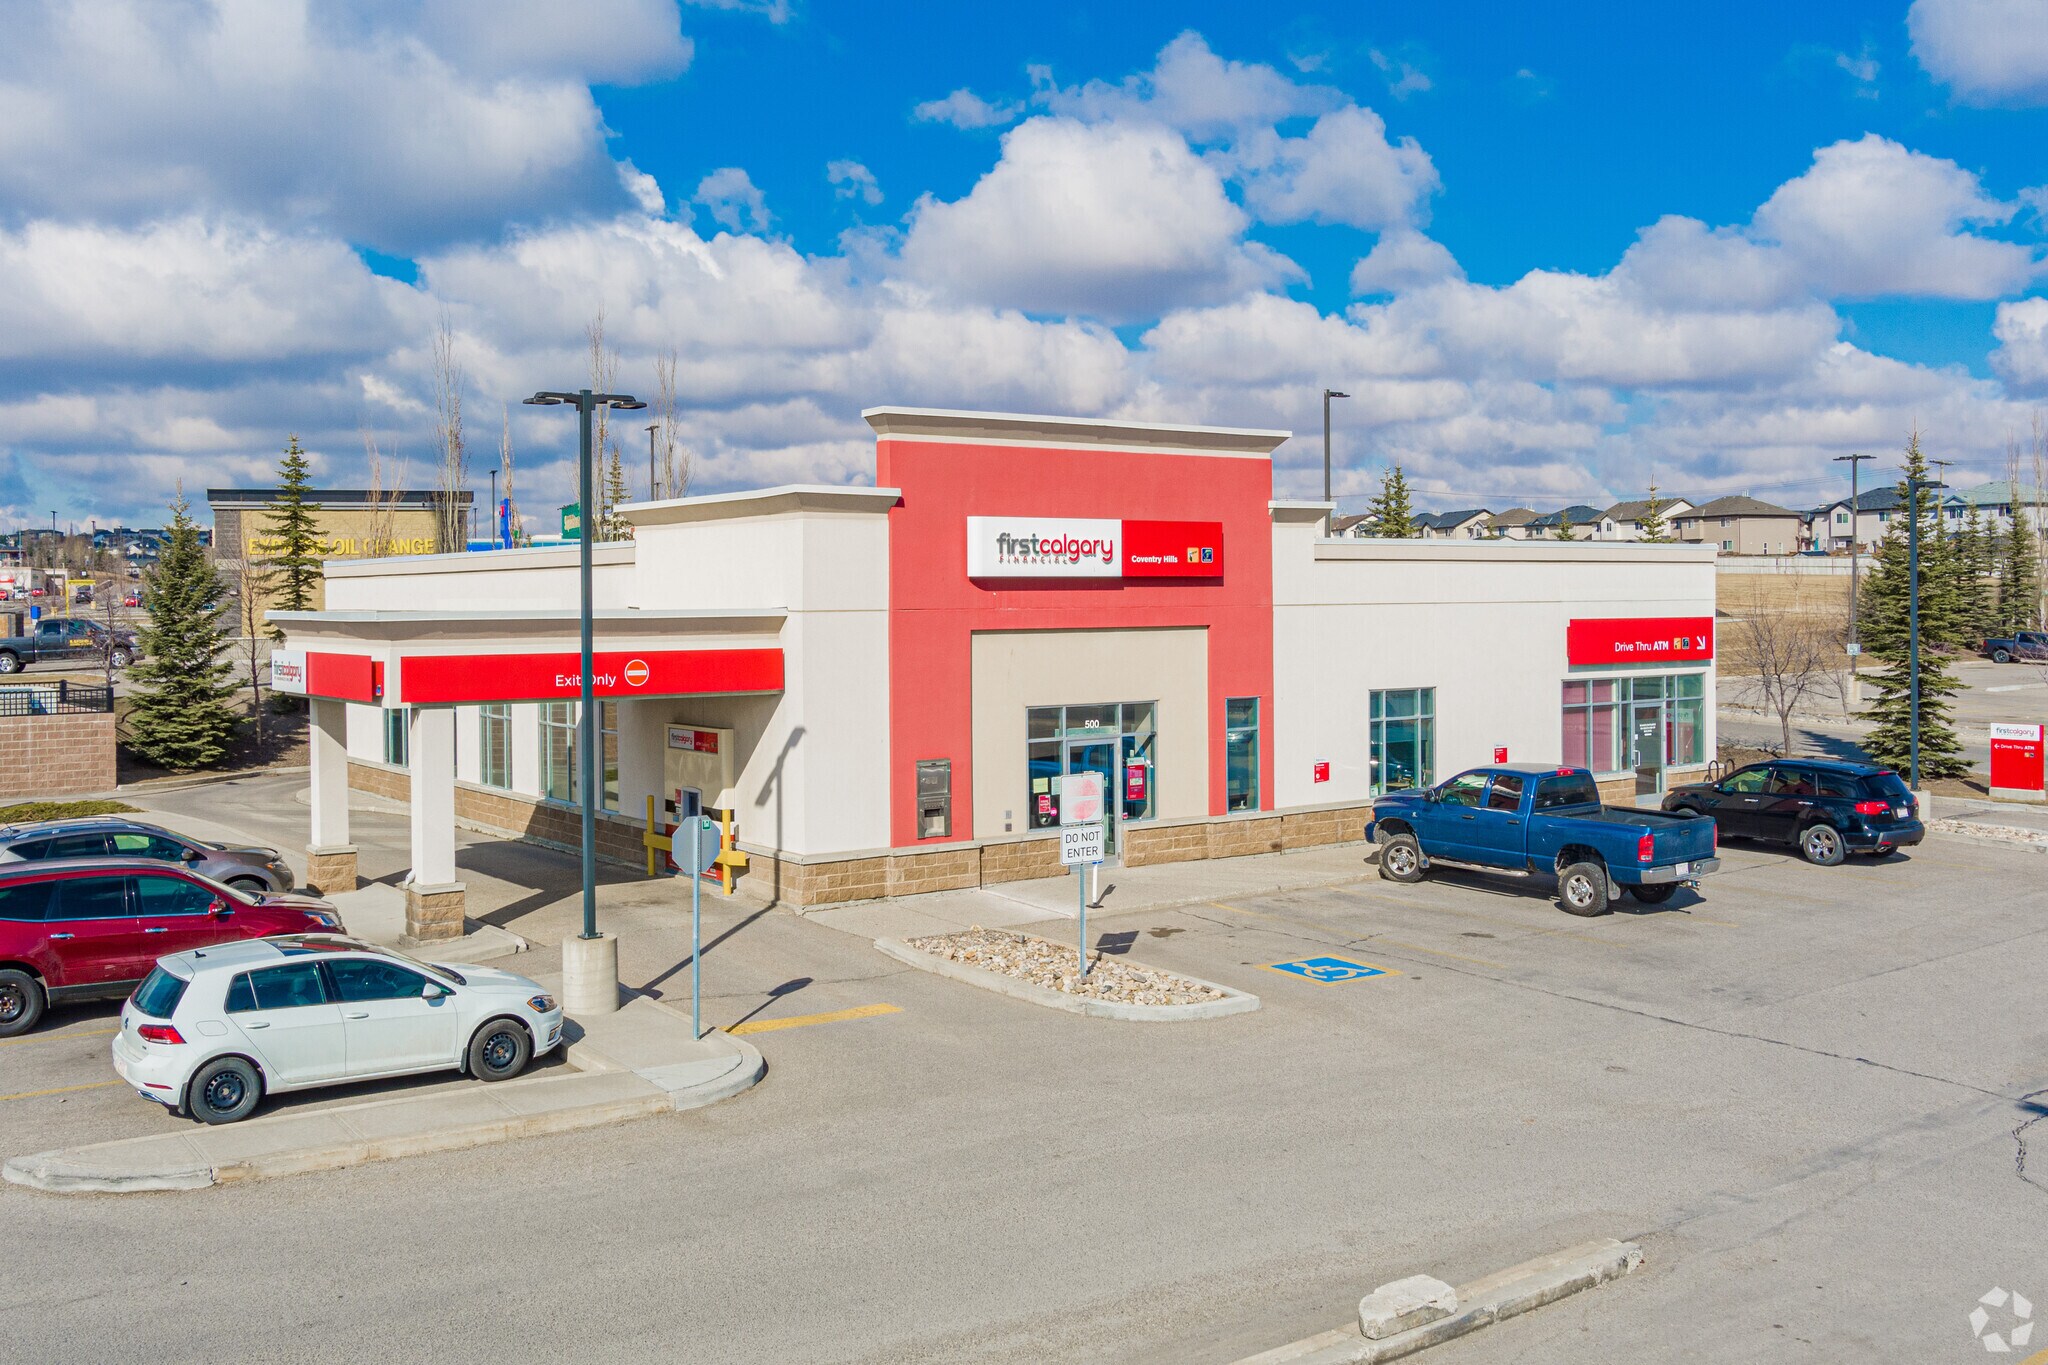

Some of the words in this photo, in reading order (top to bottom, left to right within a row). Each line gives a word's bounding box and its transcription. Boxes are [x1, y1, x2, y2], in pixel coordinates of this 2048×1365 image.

[248, 538, 328, 556] EXPRSS
[332, 537, 360, 556] OIL
[998, 553, 1068, 564] FINANCIAL
[1131, 554, 1162, 564] Coventry
[1163, 555, 1178, 563] Hills
[1614, 641, 1634, 652] Drive
[1635, 640, 1652, 651] Thru
[1653, 640, 1669, 651] ATM
[555, 674, 581, 687] Exit
[1084, 719, 1100, 729] 500
[1065, 833, 1079, 844] DO
[1081, 831, 1101, 843] NOT
[1067, 846, 1099, 858] ENTER
